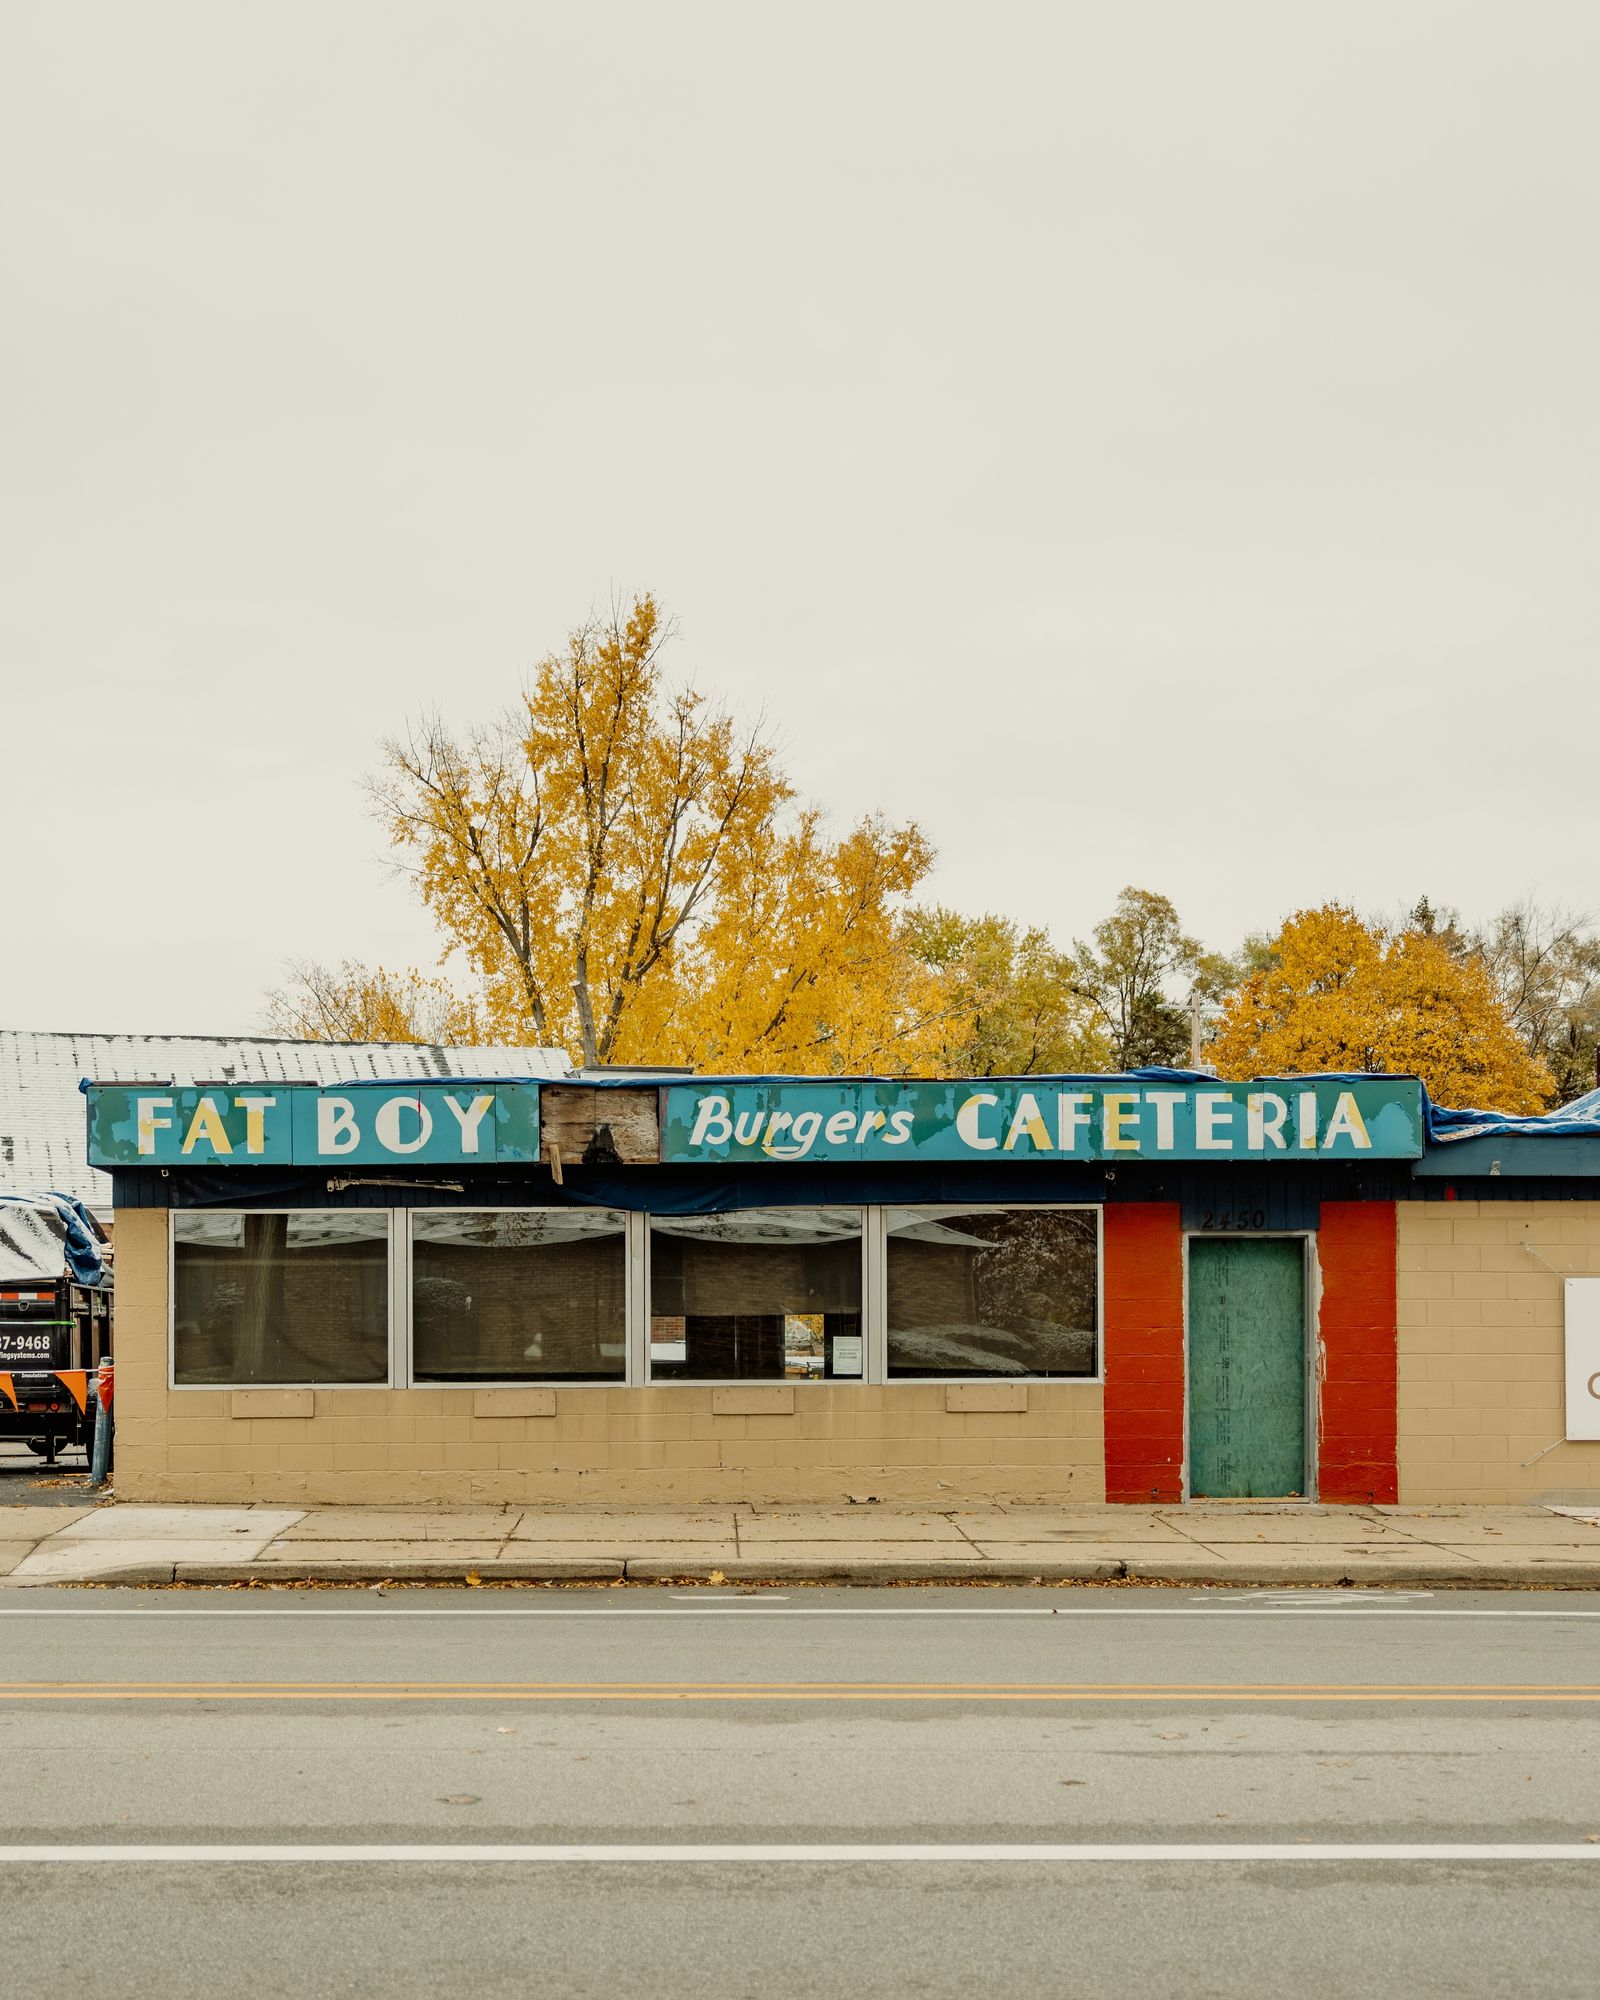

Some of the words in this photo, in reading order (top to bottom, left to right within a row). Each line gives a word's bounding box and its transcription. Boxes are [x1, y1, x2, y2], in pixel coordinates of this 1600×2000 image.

[137, 1096, 276, 1155] FAT
[317, 1095, 496, 1154] BOY
[689, 1095, 916, 1160] Burgers
[956, 1091, 1373, 1151] CAFETERIA
[1202, 1209, 1265, 1231] 2450
